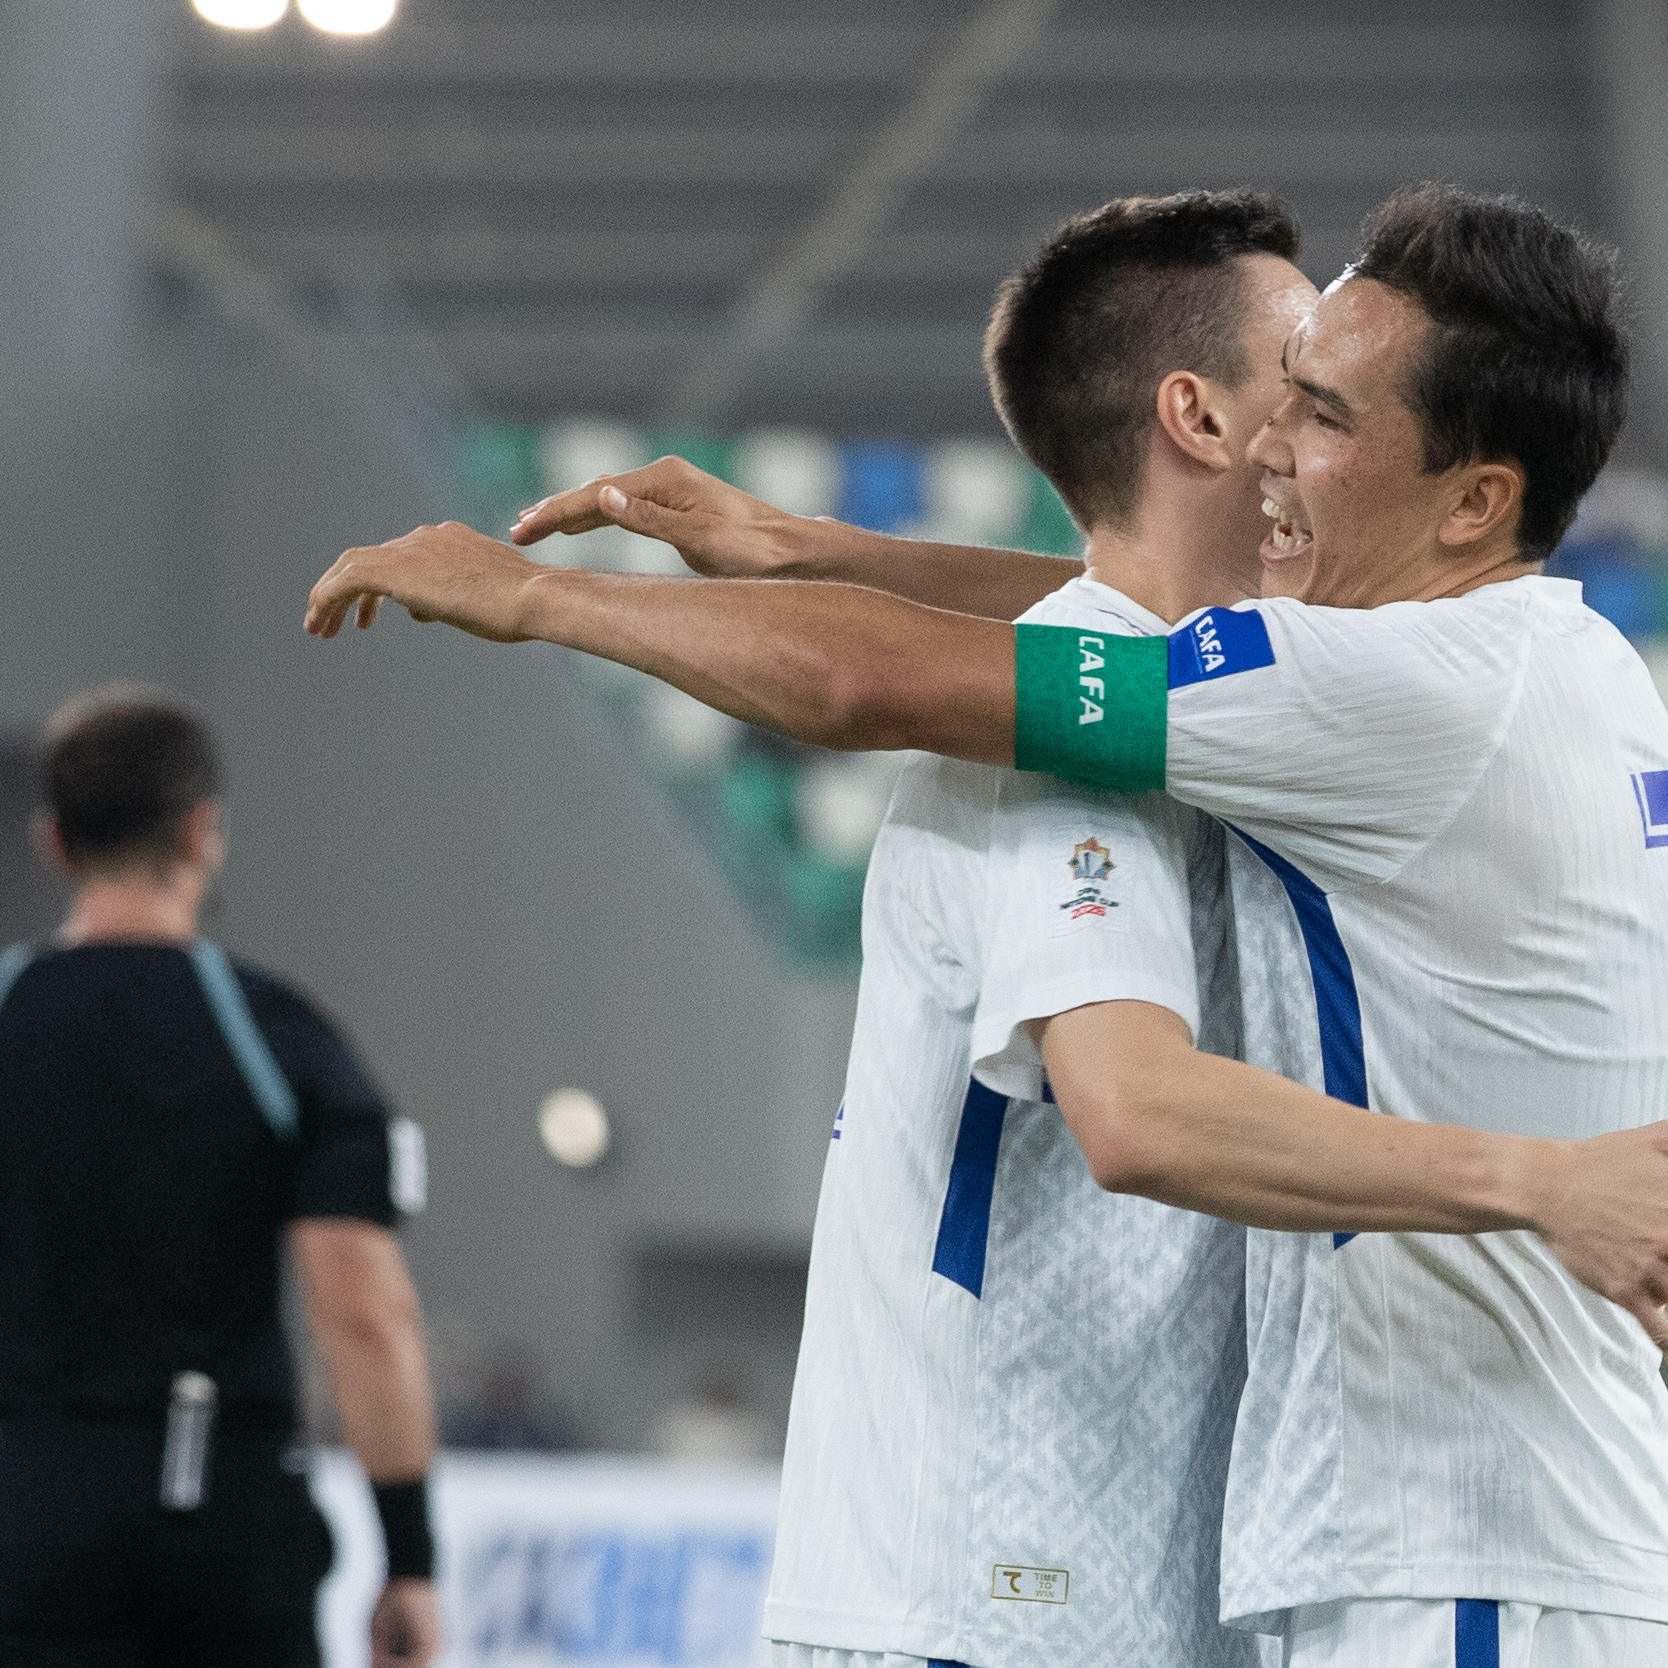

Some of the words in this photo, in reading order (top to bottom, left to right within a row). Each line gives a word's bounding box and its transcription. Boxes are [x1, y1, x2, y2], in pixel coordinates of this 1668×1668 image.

[1195, 615, 1226, 673] CAFA
[1079, 636, 1105, 726] CAFA
[1039, 1580, 1052, 1590] TO
